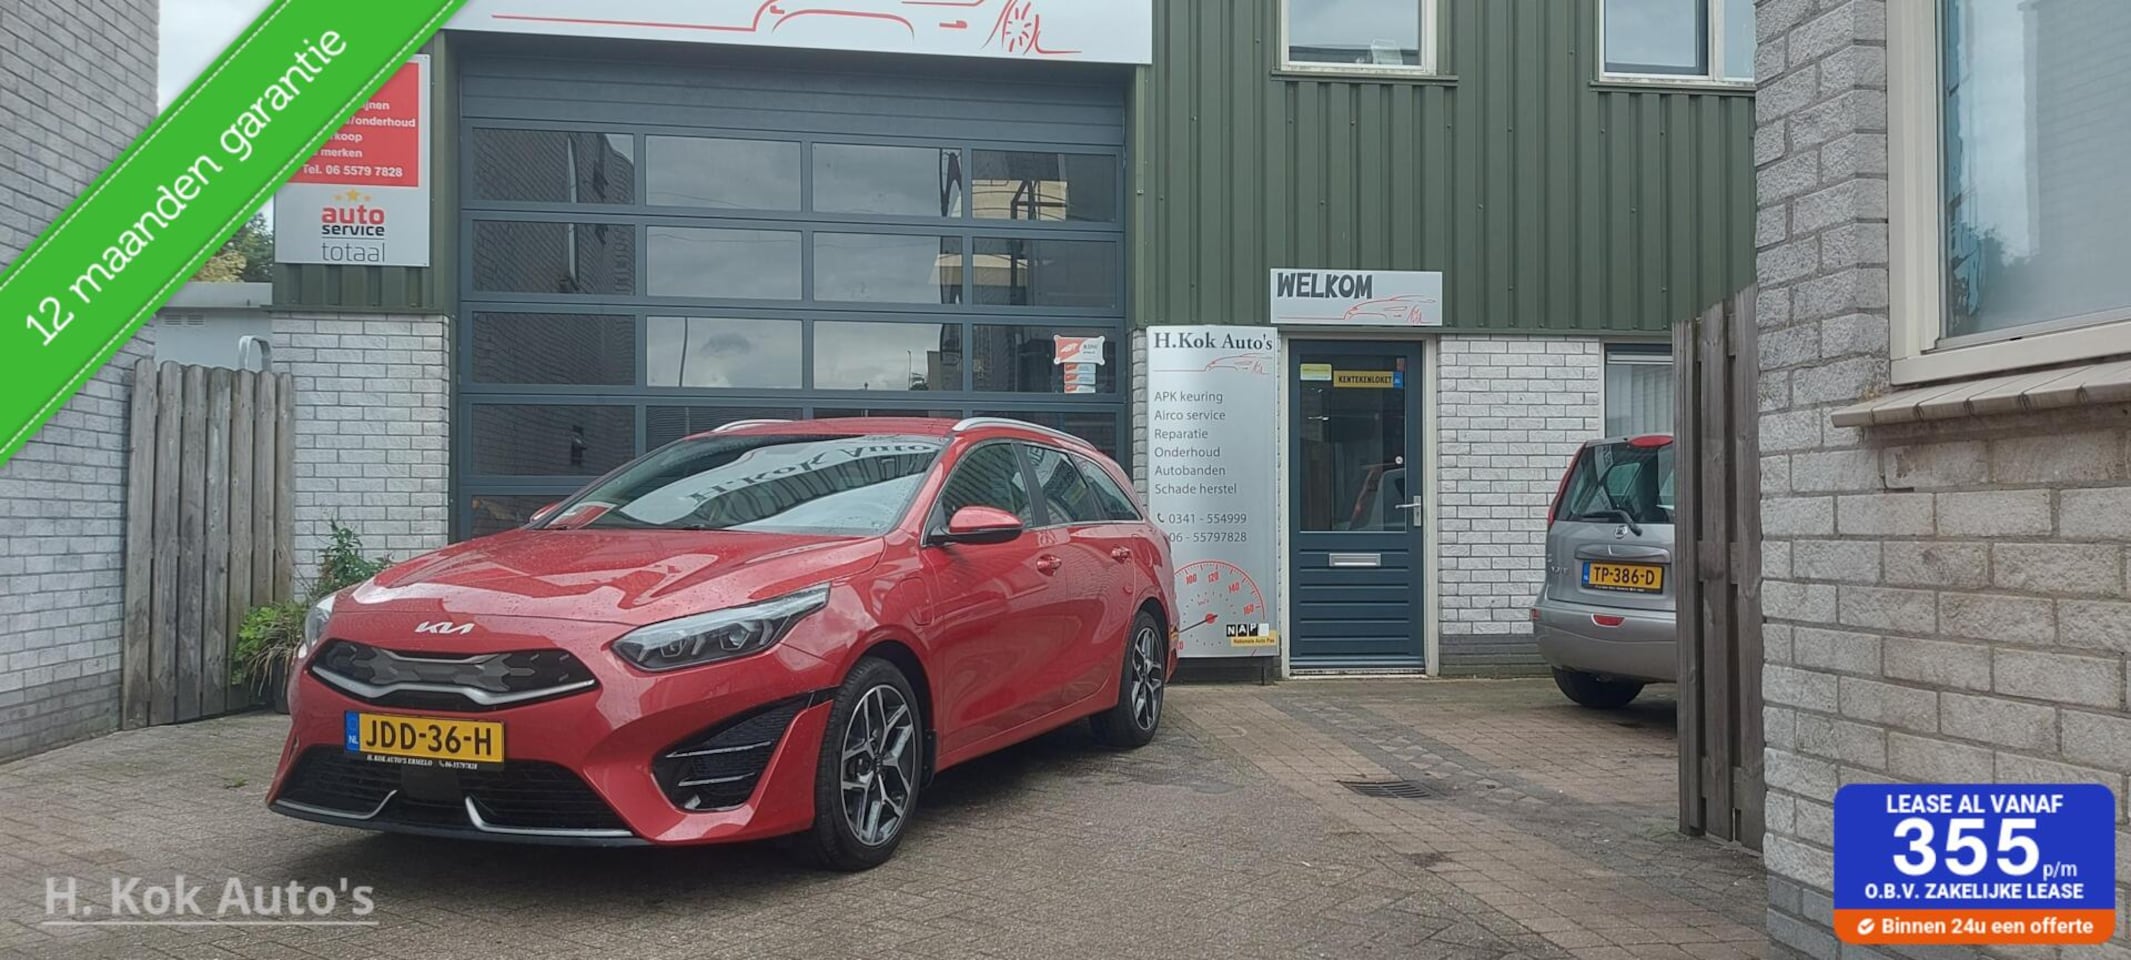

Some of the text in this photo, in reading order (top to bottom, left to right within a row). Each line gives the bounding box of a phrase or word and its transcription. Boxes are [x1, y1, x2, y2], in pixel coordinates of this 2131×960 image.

[320, 148, 363, 157] merken
[303, 164, 403, 178] Tel. 06 5579 7828
[322, 204, 385, 225] auto
[322, 224, 385, 237] service
[322, 242, 385, 262] totaal
[1277, 272, 1373, 299] WELKOM
[1154, 332, 1273, 351] H.Kok Auto's
[1338, 375, 1393, 384] KENTEKENLOKET
[1154, 391, 1224, 405] APK keuring
[1154, 409, 1226, 421] Airco service
[1155, 428, 1209, 442] Reparatie
[1154, 446, 1221, 458] Onderhoud
[1154, 464, 1226, 477] Autobanden
[1154, 482, 1237, 495] Schade herstel
[1168, 513, 1196, 524] 0341
[1207, 513, 1247, 524] 554999
[1193, 532, 1247, 543] 55797828
[1186, 573, 1198, 584] 100
[1208, 571, 1219, 583] 120
[1594, 566, 1655, 585] TP-386-D
[1228, 582, 1240, 593] 140
[1227, 623, 1258, 636] NAP
[366, 720, 492, 757] JDD-36-H
